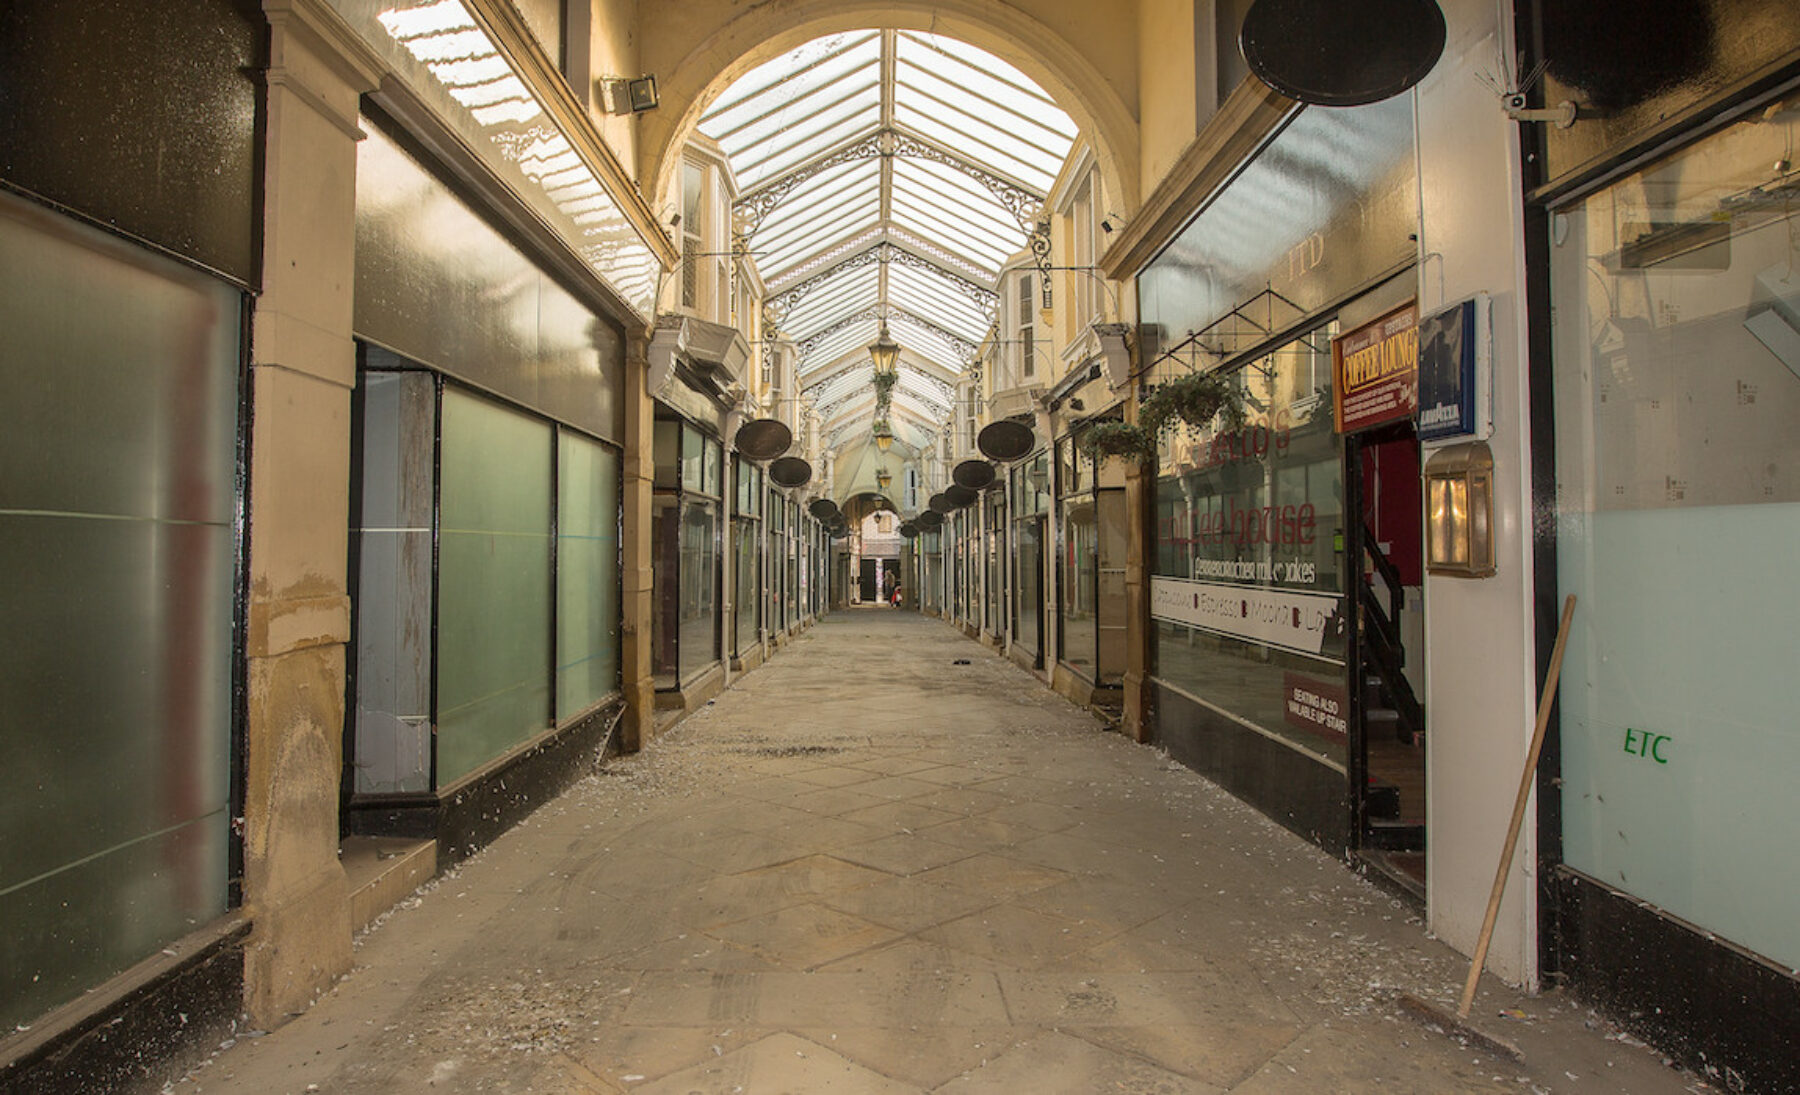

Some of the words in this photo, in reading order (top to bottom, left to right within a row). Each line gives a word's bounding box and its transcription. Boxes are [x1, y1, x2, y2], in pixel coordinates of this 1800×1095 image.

[1343, 343, 1379, 395] COFFEE
[1229, 497, 1317, 545] house
[1624, 727, 1672, 764] ETC
